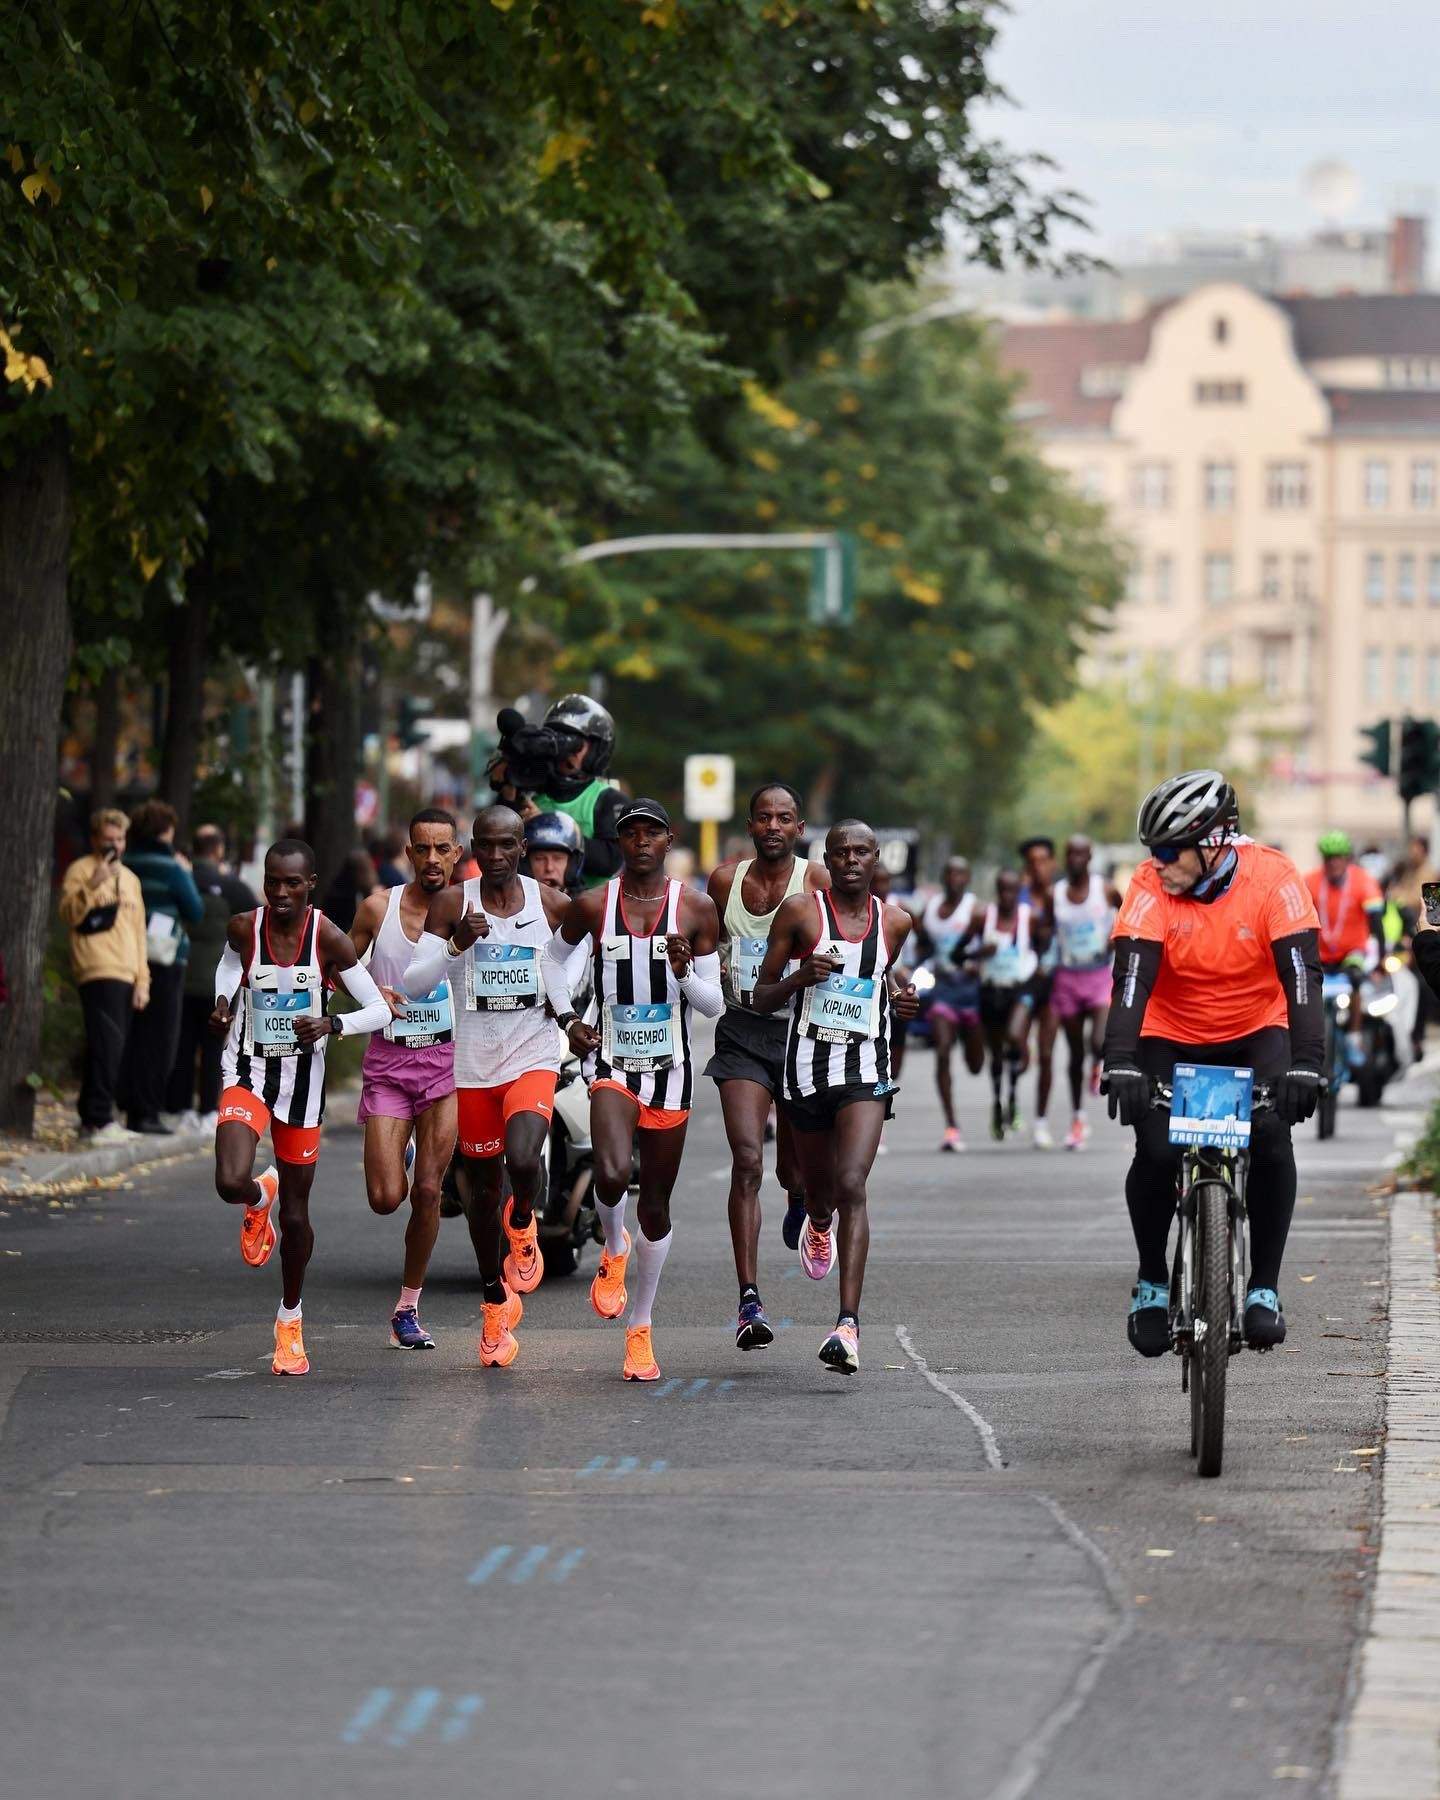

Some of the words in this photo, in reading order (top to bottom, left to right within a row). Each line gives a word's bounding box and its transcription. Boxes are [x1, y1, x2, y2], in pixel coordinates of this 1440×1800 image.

[481, 969, 530, 985] KIPCHOGE
[407, 1009, 441, 1023] BELIHU
[822, 999, 862, 1019] KIPLIMO
[405, 1034, 435, 1042] IMPOSSIBLE
[616, 1028, 668, 1045] KIPKEMBOI
[817, 1027, 850, 1038] IMPOSSIBLE
[262, 1043, 294, 1051] IMPOSSIBLE
[623, 1057, 654, 1065] IMPOSSIBLE
[462, 1138, 501, 1153] INEOS
[1171, 1132, 1204, 1143] FREIE
[1208, 1134, 1246, 1146] FAHRT
